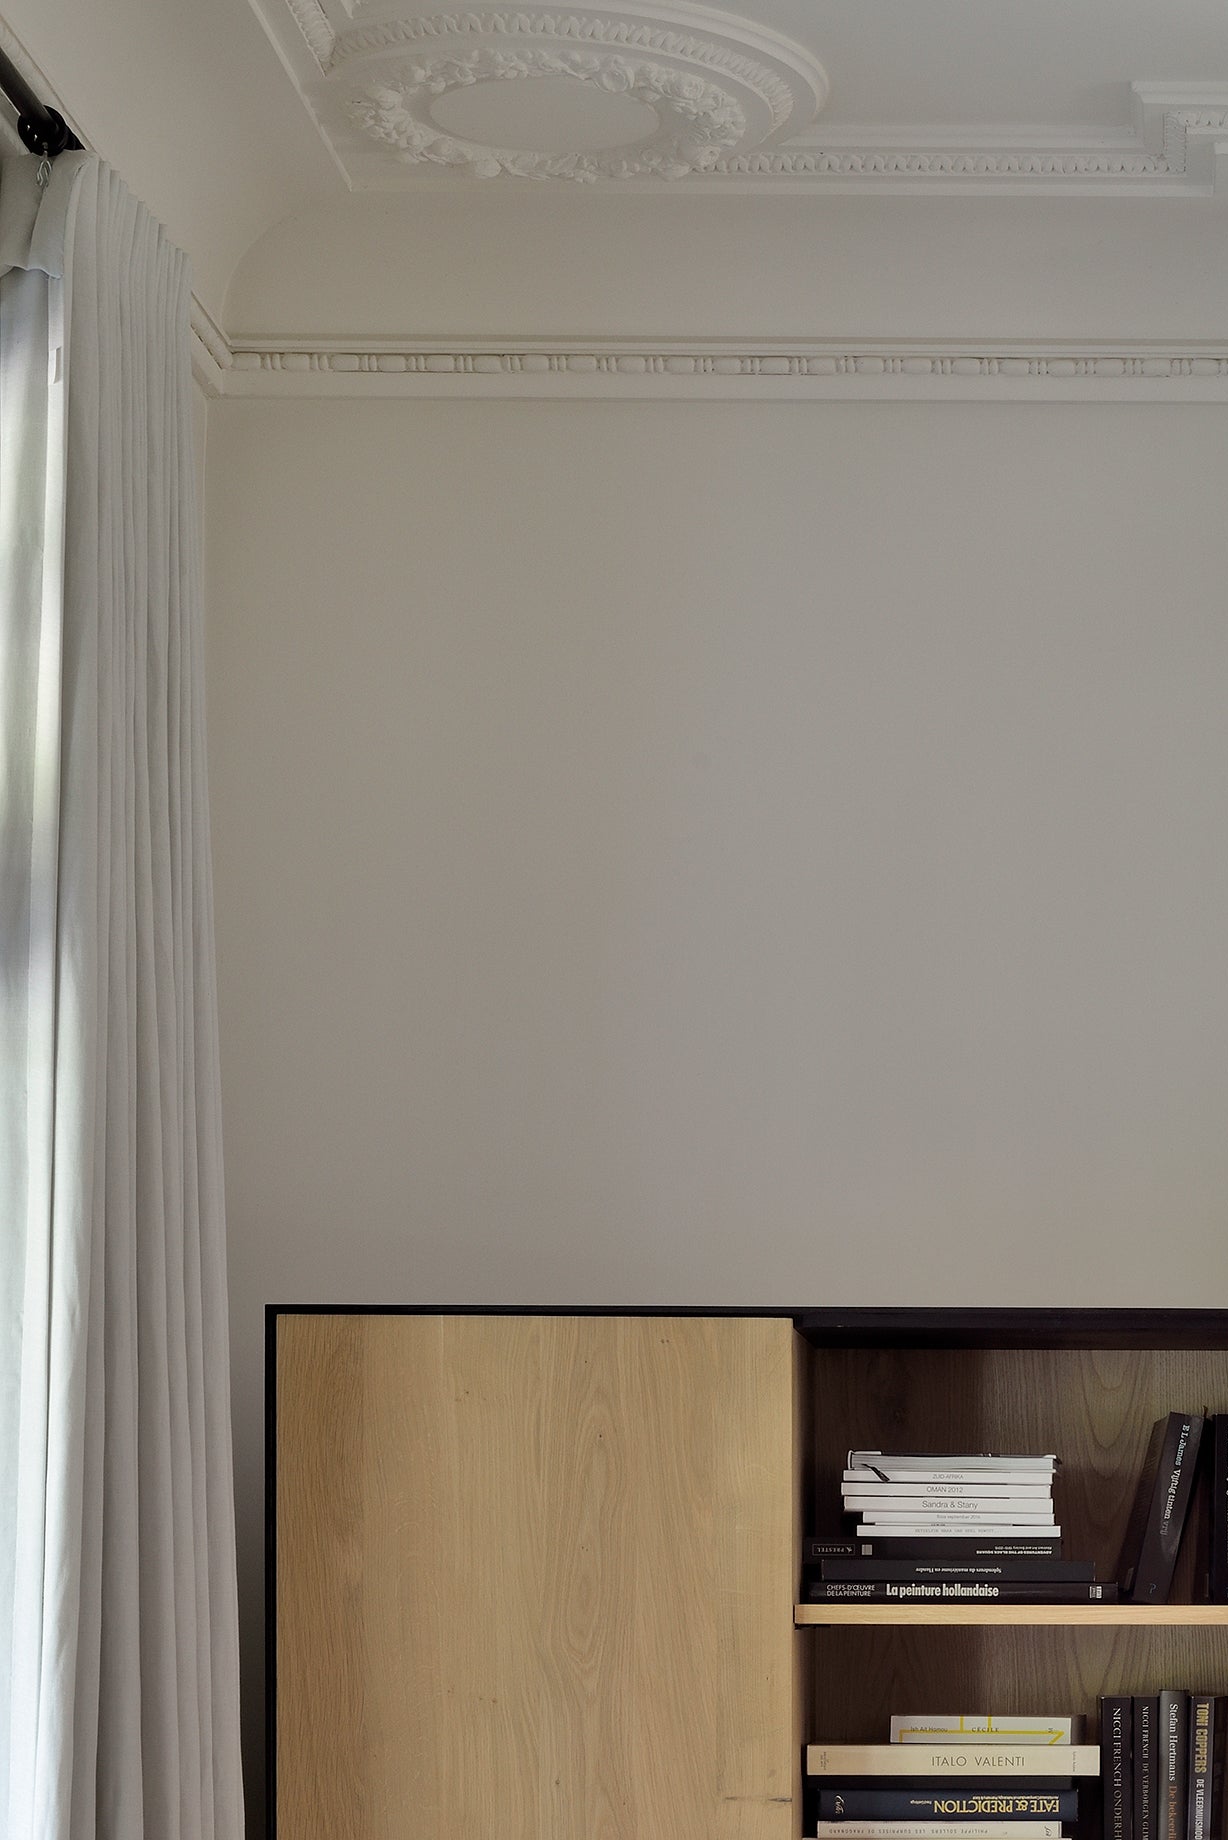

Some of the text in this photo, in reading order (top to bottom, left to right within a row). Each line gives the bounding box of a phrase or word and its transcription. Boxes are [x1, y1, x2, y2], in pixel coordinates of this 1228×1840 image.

[1182, 1424, 1190, 1432] E
[1175, 1438, 1187, 1466] James
[926, 1486, 947, 1494] OMAN
[1167, 1469, 1181, 1496] Vijftig
[922, 1500, 978, 1510] Sandra & Stany
[1164, 1496, 1176, 1520] tinten
[886, 1583, 999, 1598] La peinture hollandaise
[1112, 1708, 1122, 1740] NICCI
[1169, 1704, 1179, 1733] Stefan
[1196, 1702, 1210, 1726] TONI
[931, 1756, 1025, 1767] ITALO VALENTI
[1169, 1735, 1178, 1781] Hertmans
[1194, 1728, 1208, 1774] COPPERS
[1113, 1741, 1122, 1787] FRENCH
[1142, 1763, 1149, 1773] DE
[1169, 1786, 1177, 1799] De
[1196, 1778, 1205, 1788] DE
[934, 1800, 1060, 1812] FATE & PREDICTION
[1142, 1774, 1150, 1820] VERBORGEN
